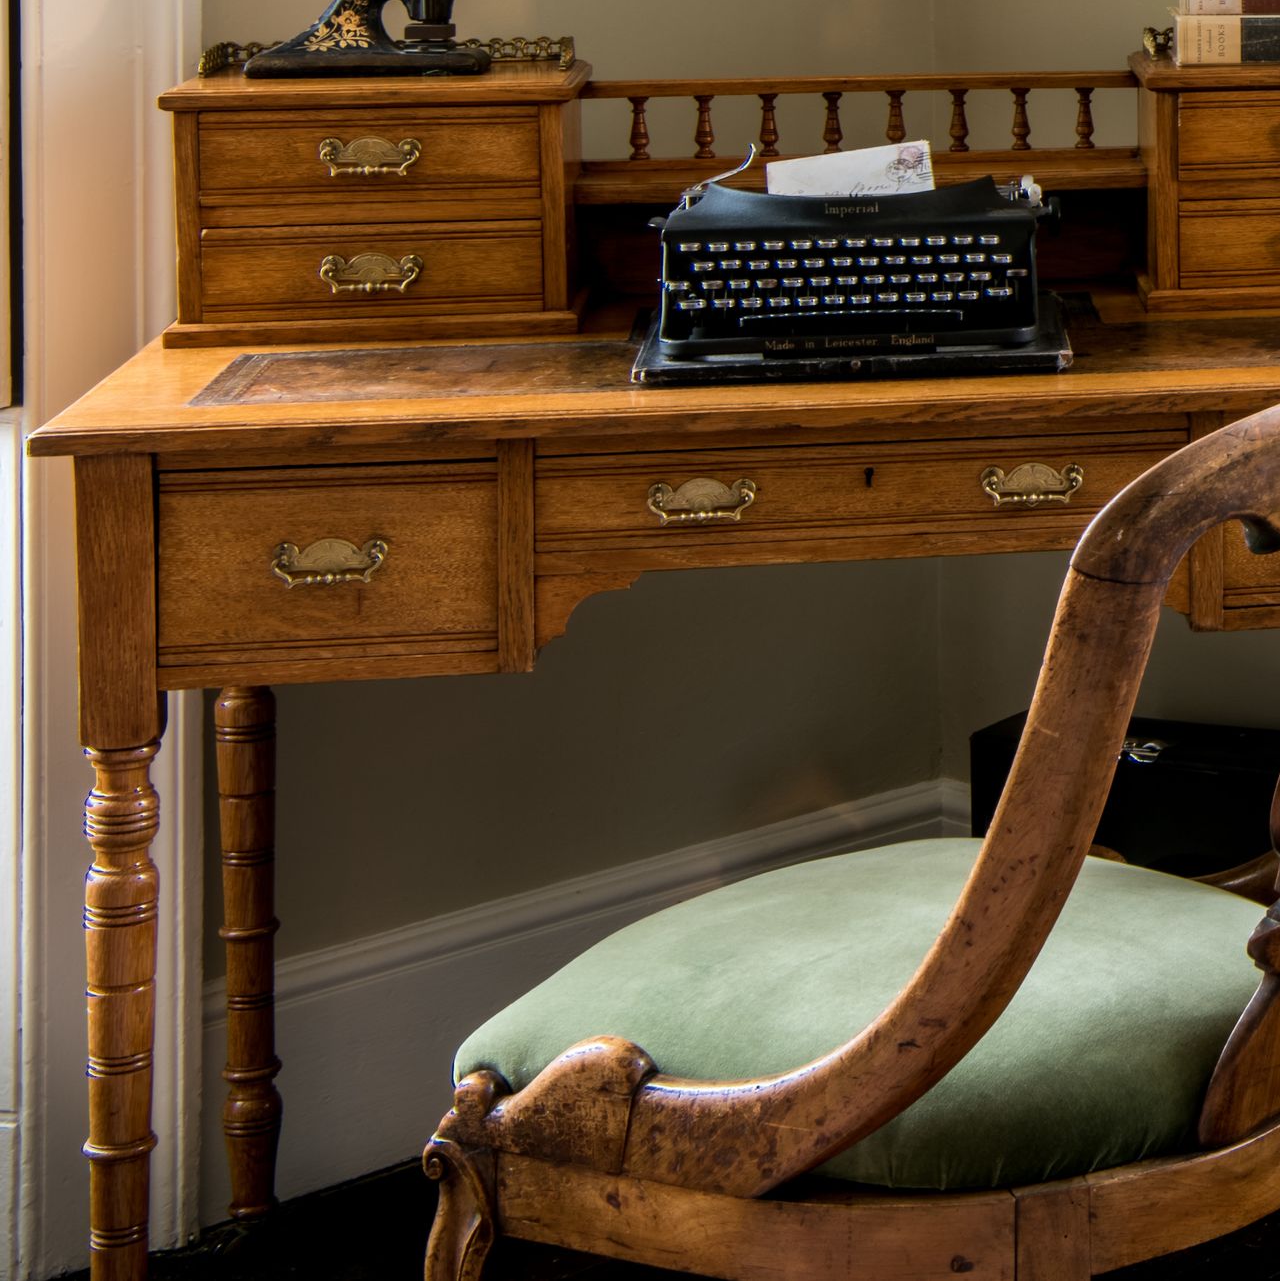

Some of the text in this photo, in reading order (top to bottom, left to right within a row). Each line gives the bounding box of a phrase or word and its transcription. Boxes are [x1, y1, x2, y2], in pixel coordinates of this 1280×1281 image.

[1217, 23, 1225, 57] BOOKS
[824, 203, 880, 218] Imperial
[765, 340, 796, 351] Made
[805, 340, 815, 349] in
[890, 334, 935, 346] England
